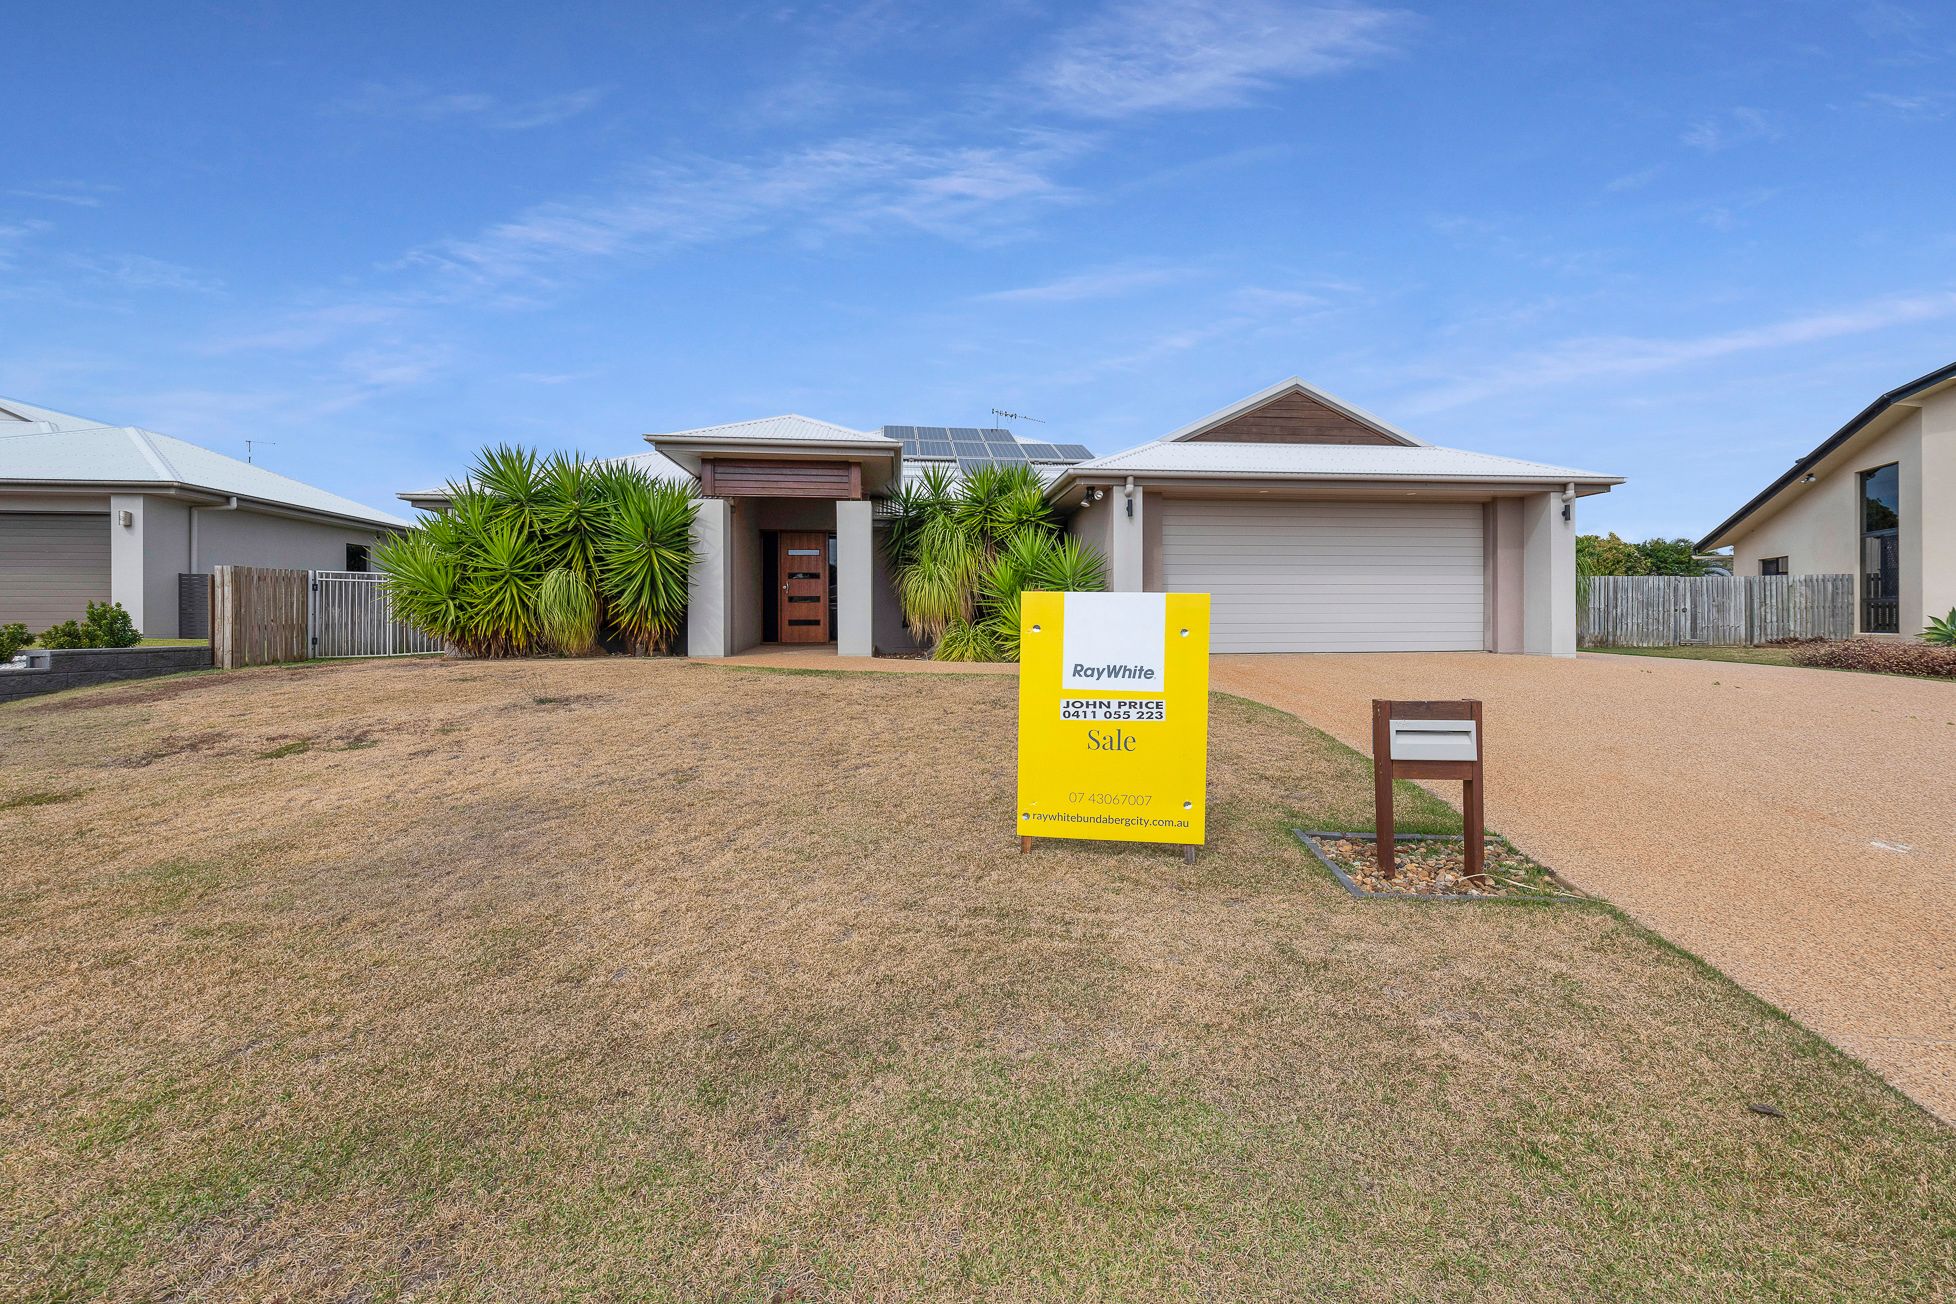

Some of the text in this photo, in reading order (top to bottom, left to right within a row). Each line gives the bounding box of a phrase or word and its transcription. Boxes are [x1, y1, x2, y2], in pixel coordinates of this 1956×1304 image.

[1072, 663, 1155, 681] RayWhite
[1062, 700, 1164, 710] JOHN PRICE
[1062, 710, 1164, 720] 0411 055 223
[1087, 728, 1137, 752] Sale
[1068, 792, 1152, 806] 07 43067007
[1032, 812, 1189, 828] raywhitebundabergcity.com.au
